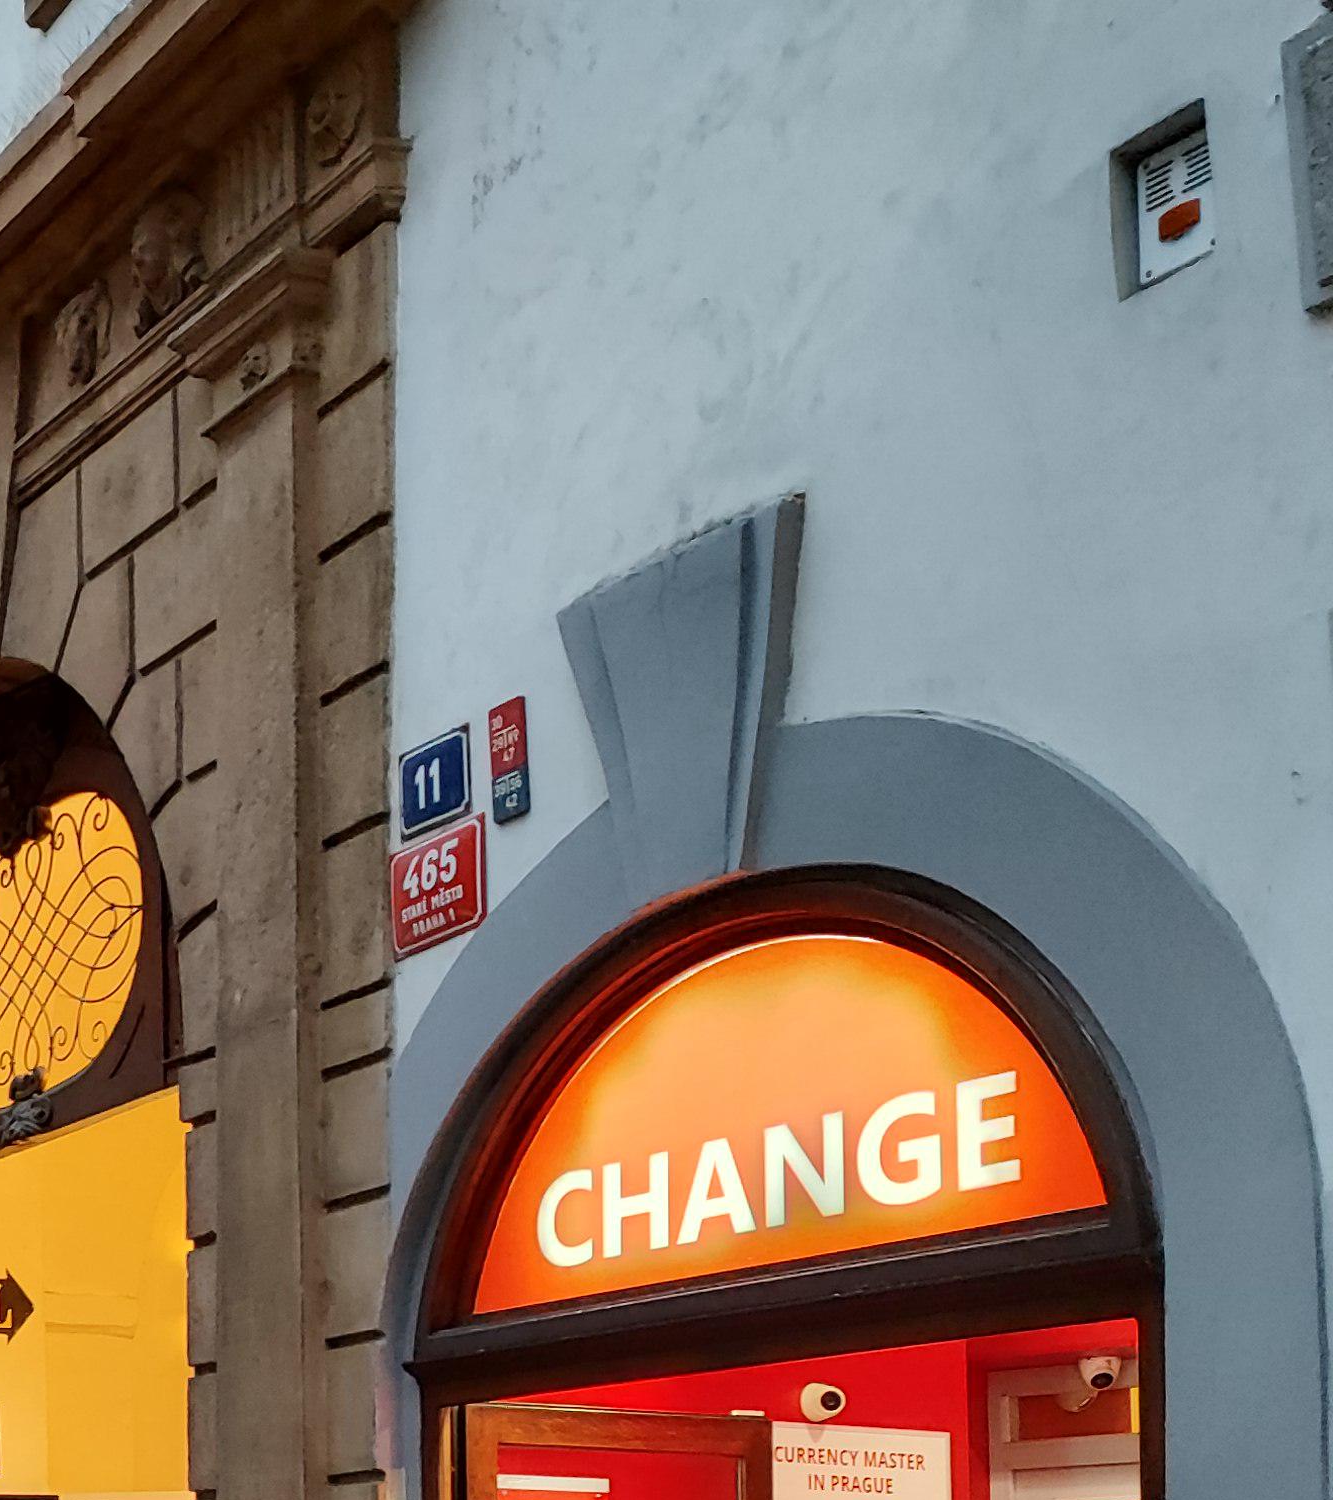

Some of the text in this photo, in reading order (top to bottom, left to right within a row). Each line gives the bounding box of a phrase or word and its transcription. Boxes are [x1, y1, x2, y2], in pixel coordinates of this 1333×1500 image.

[414, 757, 440, 810] 11
[402, 837, 459, 899] 465
[448, 907, 456, 922] 1
[536, 1070, 1022, 1269] CHANGE
[773, 1446, 927, 1472] CURRENCY MASTER
[807, 1474, 894, 1495] IN PRAGUE
